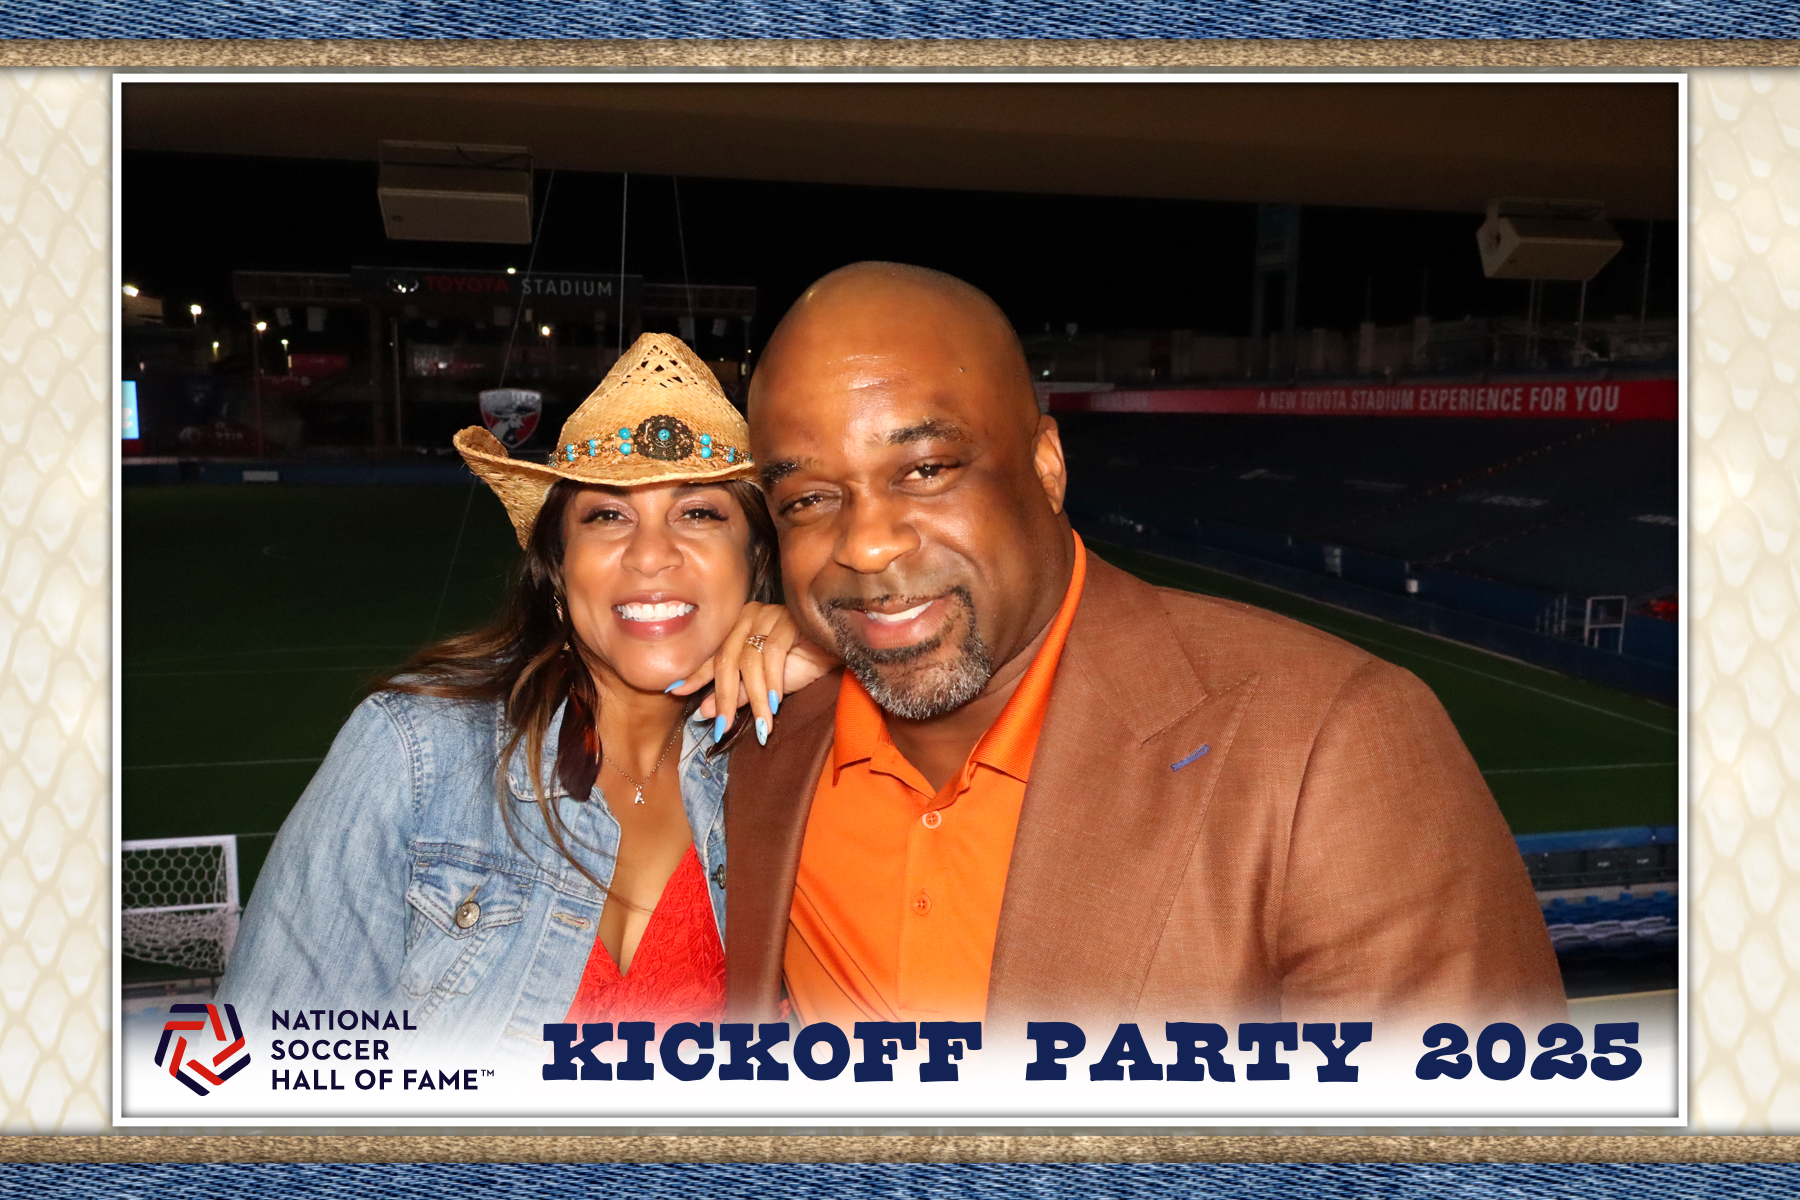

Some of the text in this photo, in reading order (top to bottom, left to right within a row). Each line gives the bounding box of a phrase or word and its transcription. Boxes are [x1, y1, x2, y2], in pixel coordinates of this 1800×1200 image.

[424, 275, 613, 297] TOYOTA STADIUM
[1257, 385, 1621, 412] A NEW TOYOTA STADIUM EXPERIENCE FOR YOU
